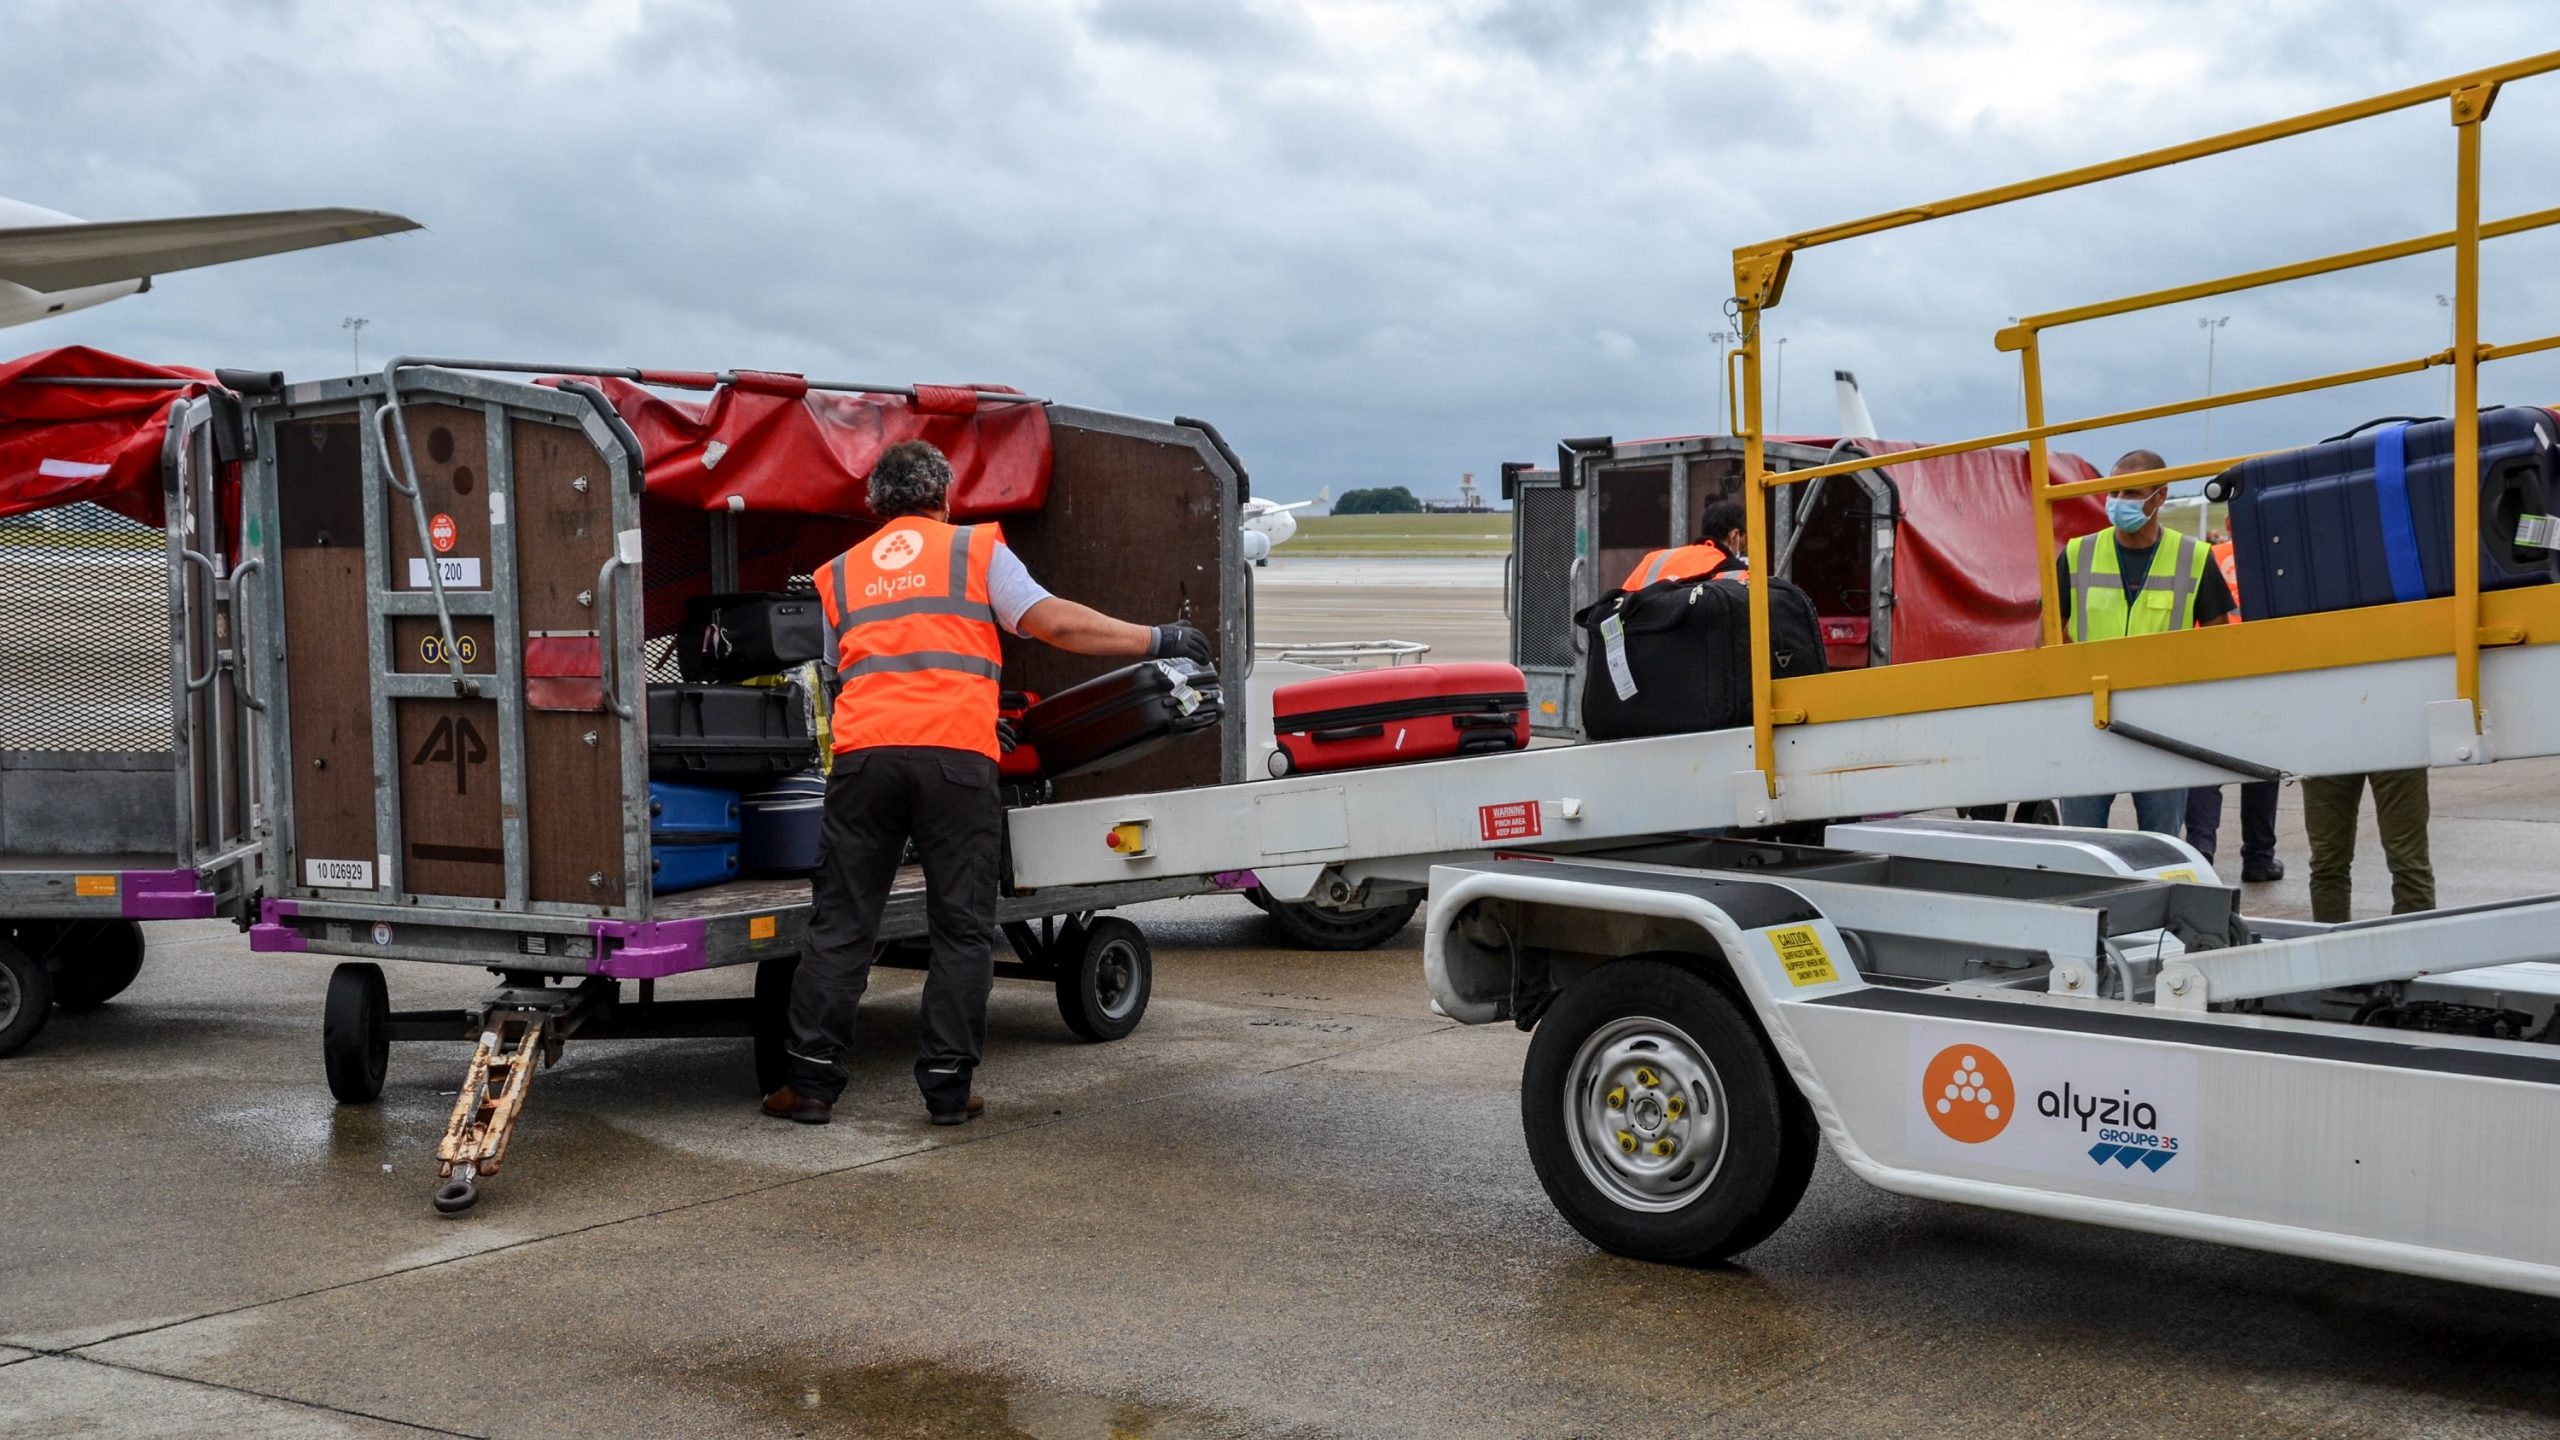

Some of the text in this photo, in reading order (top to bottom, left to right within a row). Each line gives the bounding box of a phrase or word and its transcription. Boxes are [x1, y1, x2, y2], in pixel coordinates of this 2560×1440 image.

[445, 563, 462, 581] 200
[864, 570, 926, 598] alyzia
[1492, 805, 1526, 818] WARNING
[1496, 828, 1510, 836] KEEP
[317, 862, 363, 880] 10 026929
[1777, 931, 1812, 947] CAUTION
[2037, 1081, 2157, 1133] alyzia
[2160, 1135, 2179, 1150] 3S
